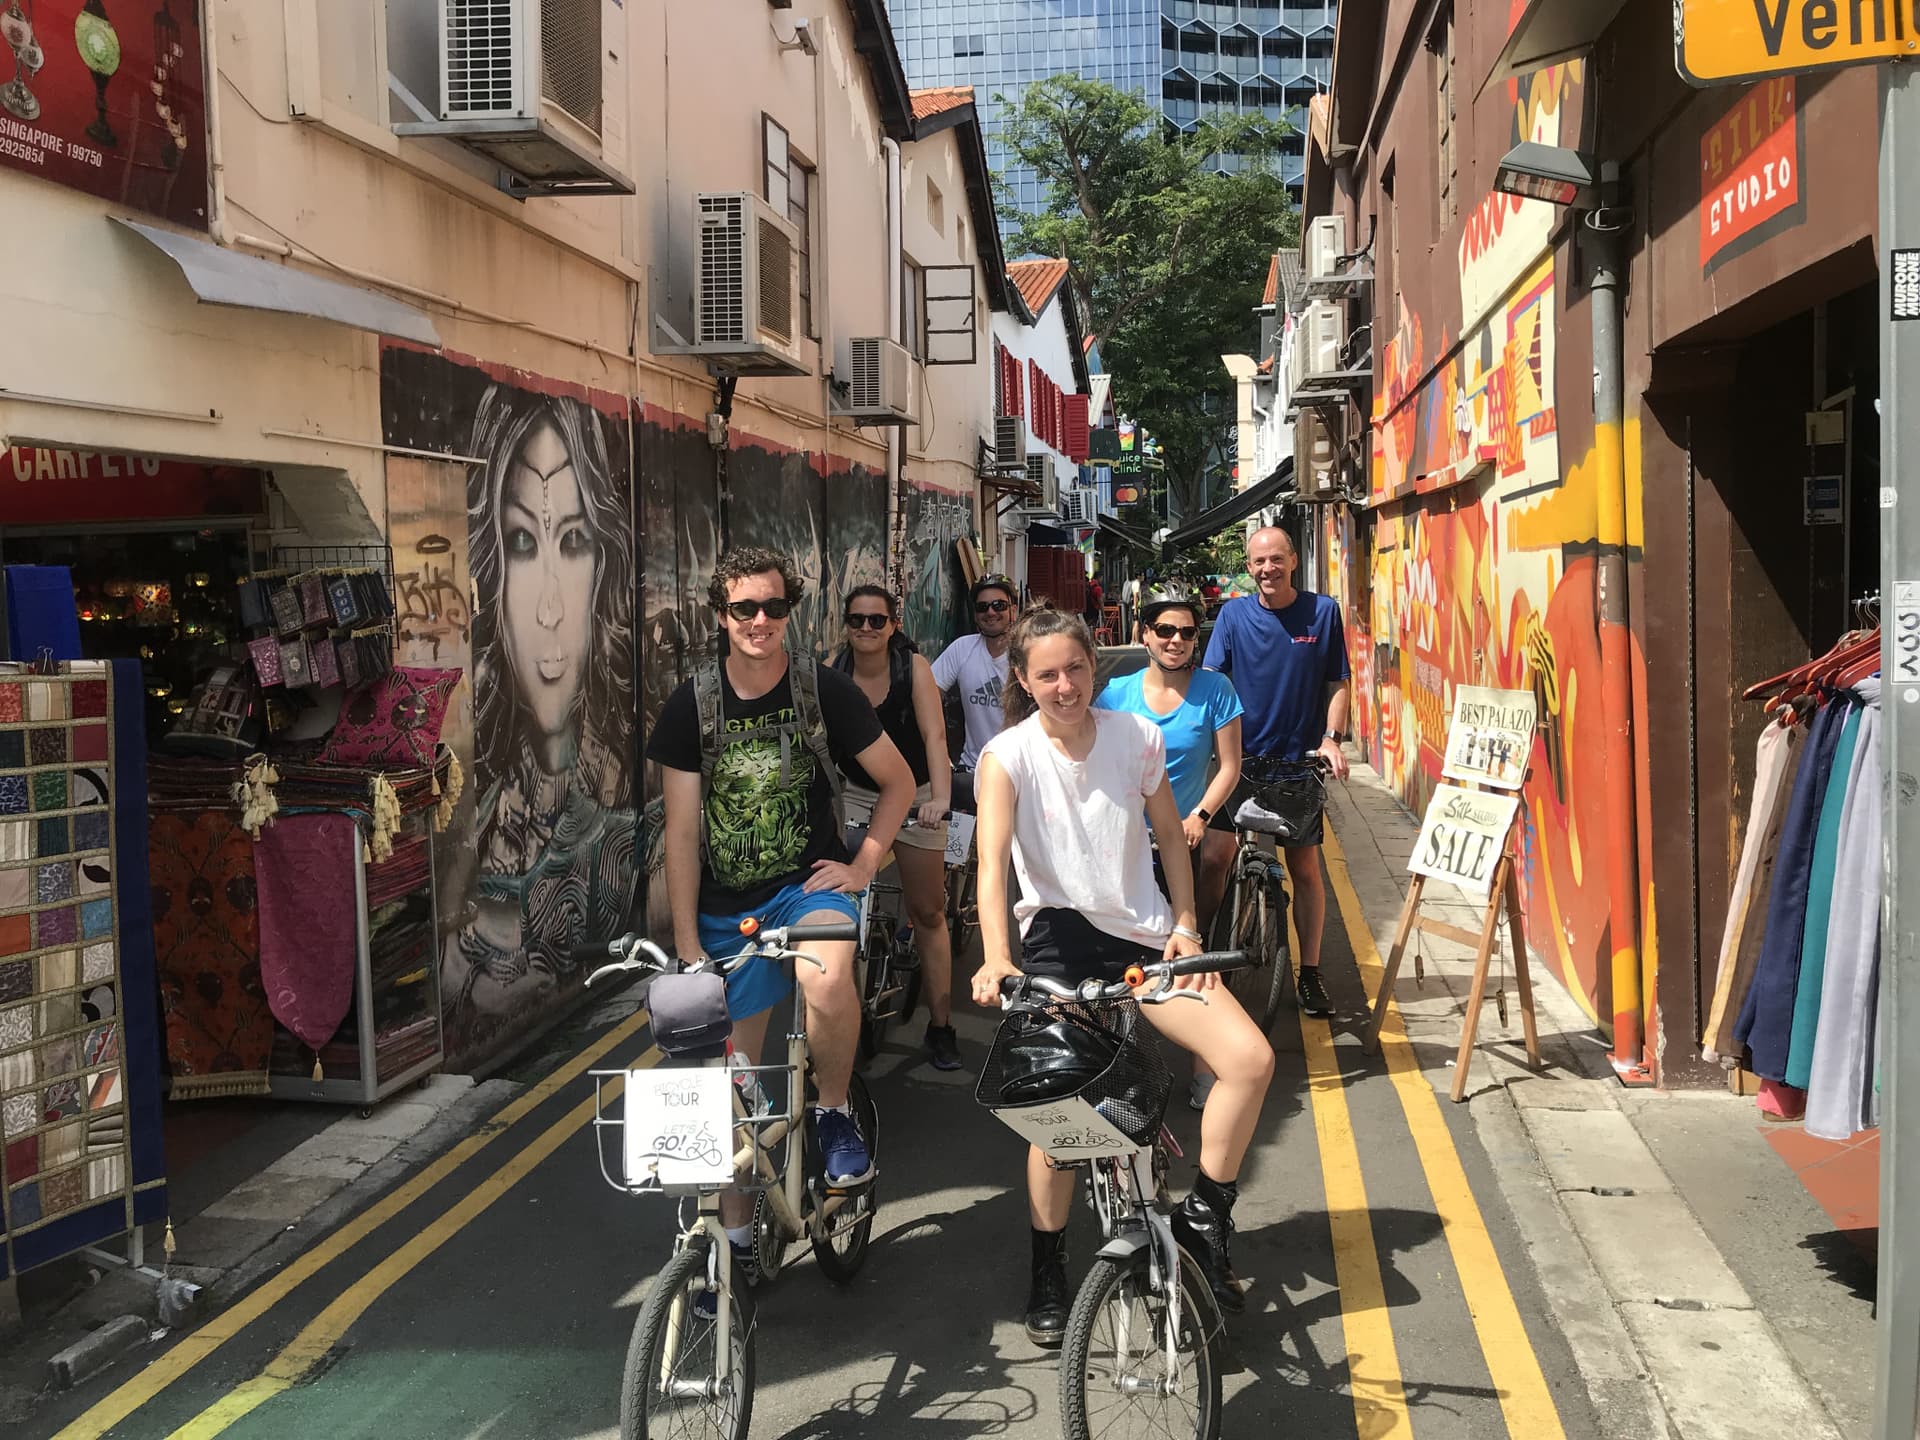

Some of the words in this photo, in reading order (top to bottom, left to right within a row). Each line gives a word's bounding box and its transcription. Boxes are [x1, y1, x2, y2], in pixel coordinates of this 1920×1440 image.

[1710, 77, 1785, 179] SILK
[0, 118, 63, 153] SINGAPORE
[67, 143, 102, 167] 199750
[0, 138, 44, 165] 2925854
[1711, 156, 1791, 236] STUDIO
[1894, 252, 1907, 316] MURONE
[1907, 252, 1919, 316] MURONE
[1113, 462, 1142, 474] Clinic
[1119, 453, 1141, 463] uice
[1460, 702, 1487, 726] BEST
[1488, 705, 1533, 731] PALAZO
[1444, 794, 1473, 820] Silk
[1423, 823, 1494, 882] SALE
[662, 1091, 700, 1107] TOUR
[664, 1123, 697, 1135] LET'S
[1032, 1114, 1071, 1126] TOUR
[652, 1134, 687, 1151] GO!
[1052, 1135, 1081, 1146] GO!
